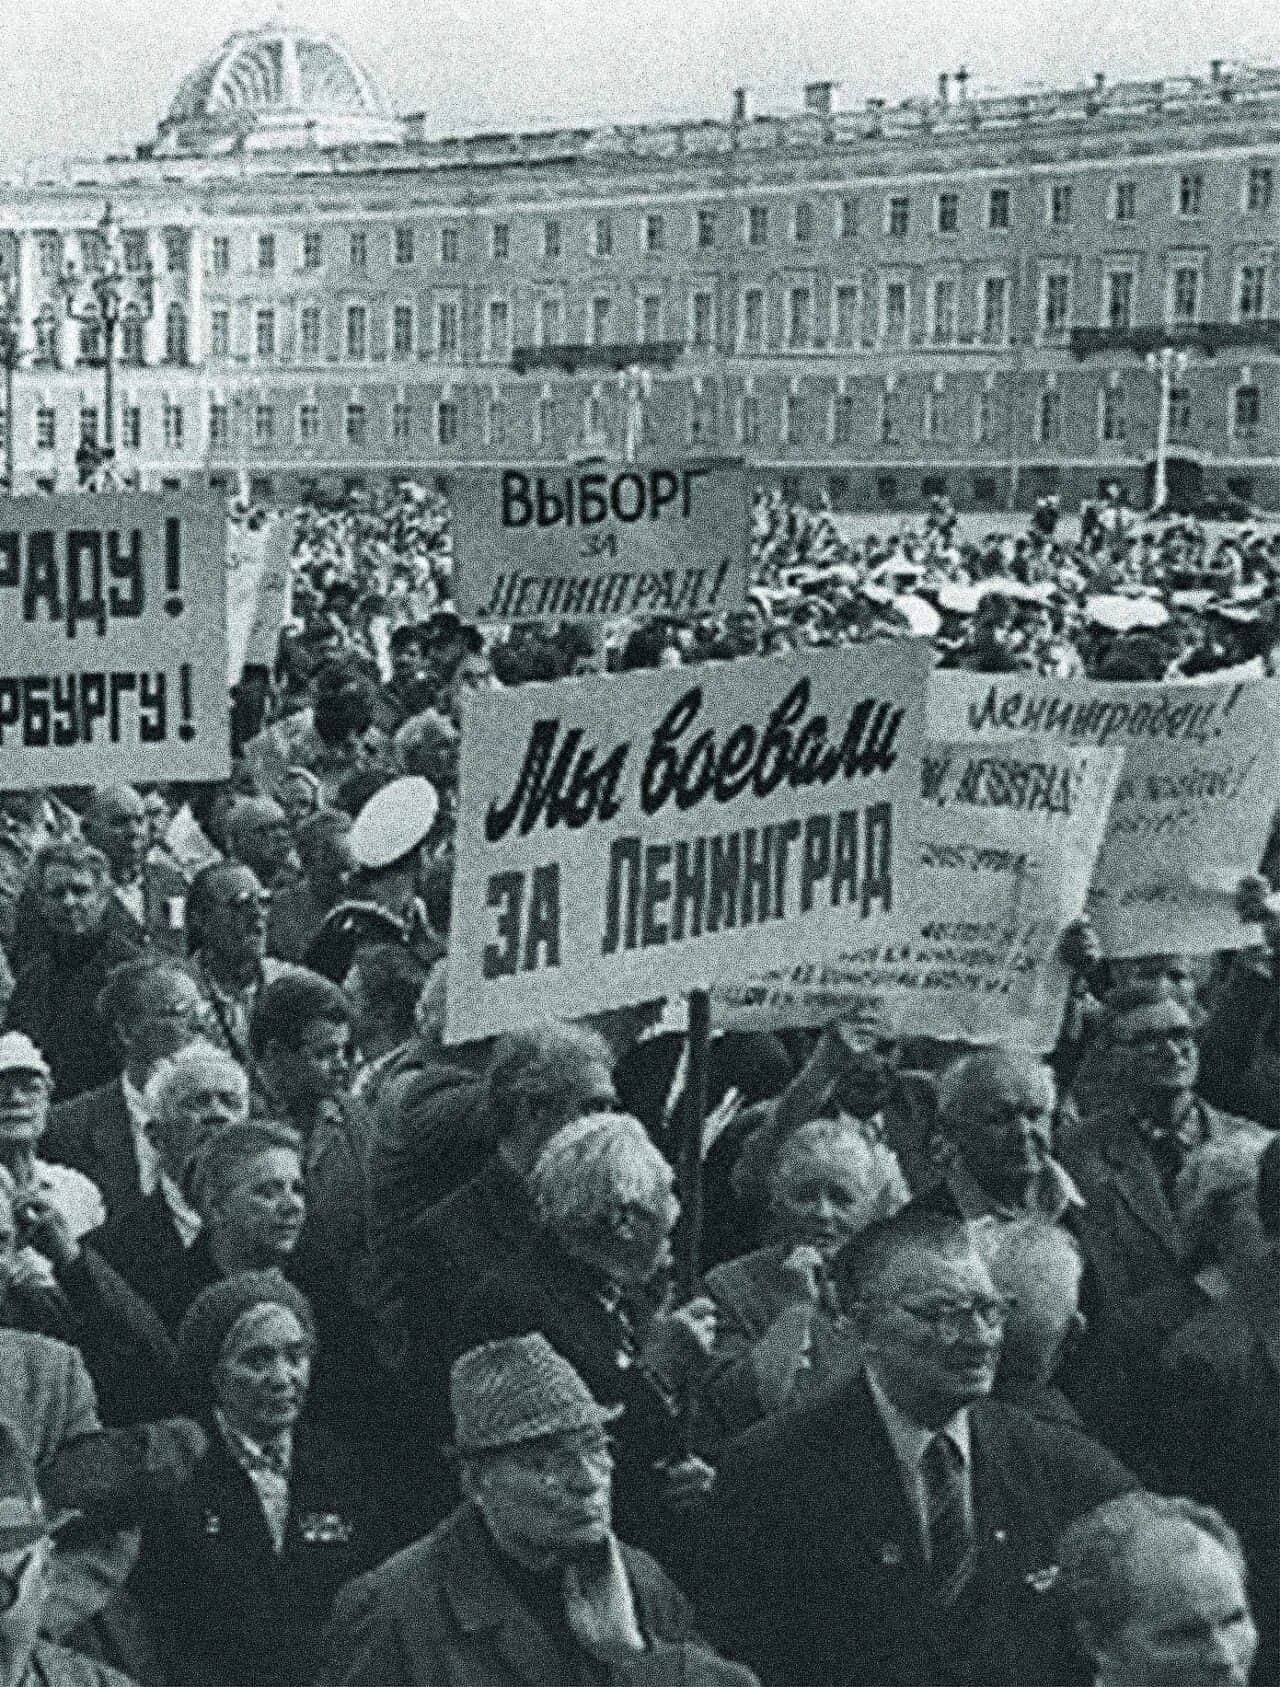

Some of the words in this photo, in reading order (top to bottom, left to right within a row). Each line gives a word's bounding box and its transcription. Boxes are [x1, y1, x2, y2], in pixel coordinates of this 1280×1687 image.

[501, 468, 709, 527] ВЫБОРГ
[484, 719, 630, 842] Мы
[639, 677, 906, 816] воевали
[482, 863, 561, 979] ЗА
[600, 801, 892, 956] ЛЕНИНГРАД
